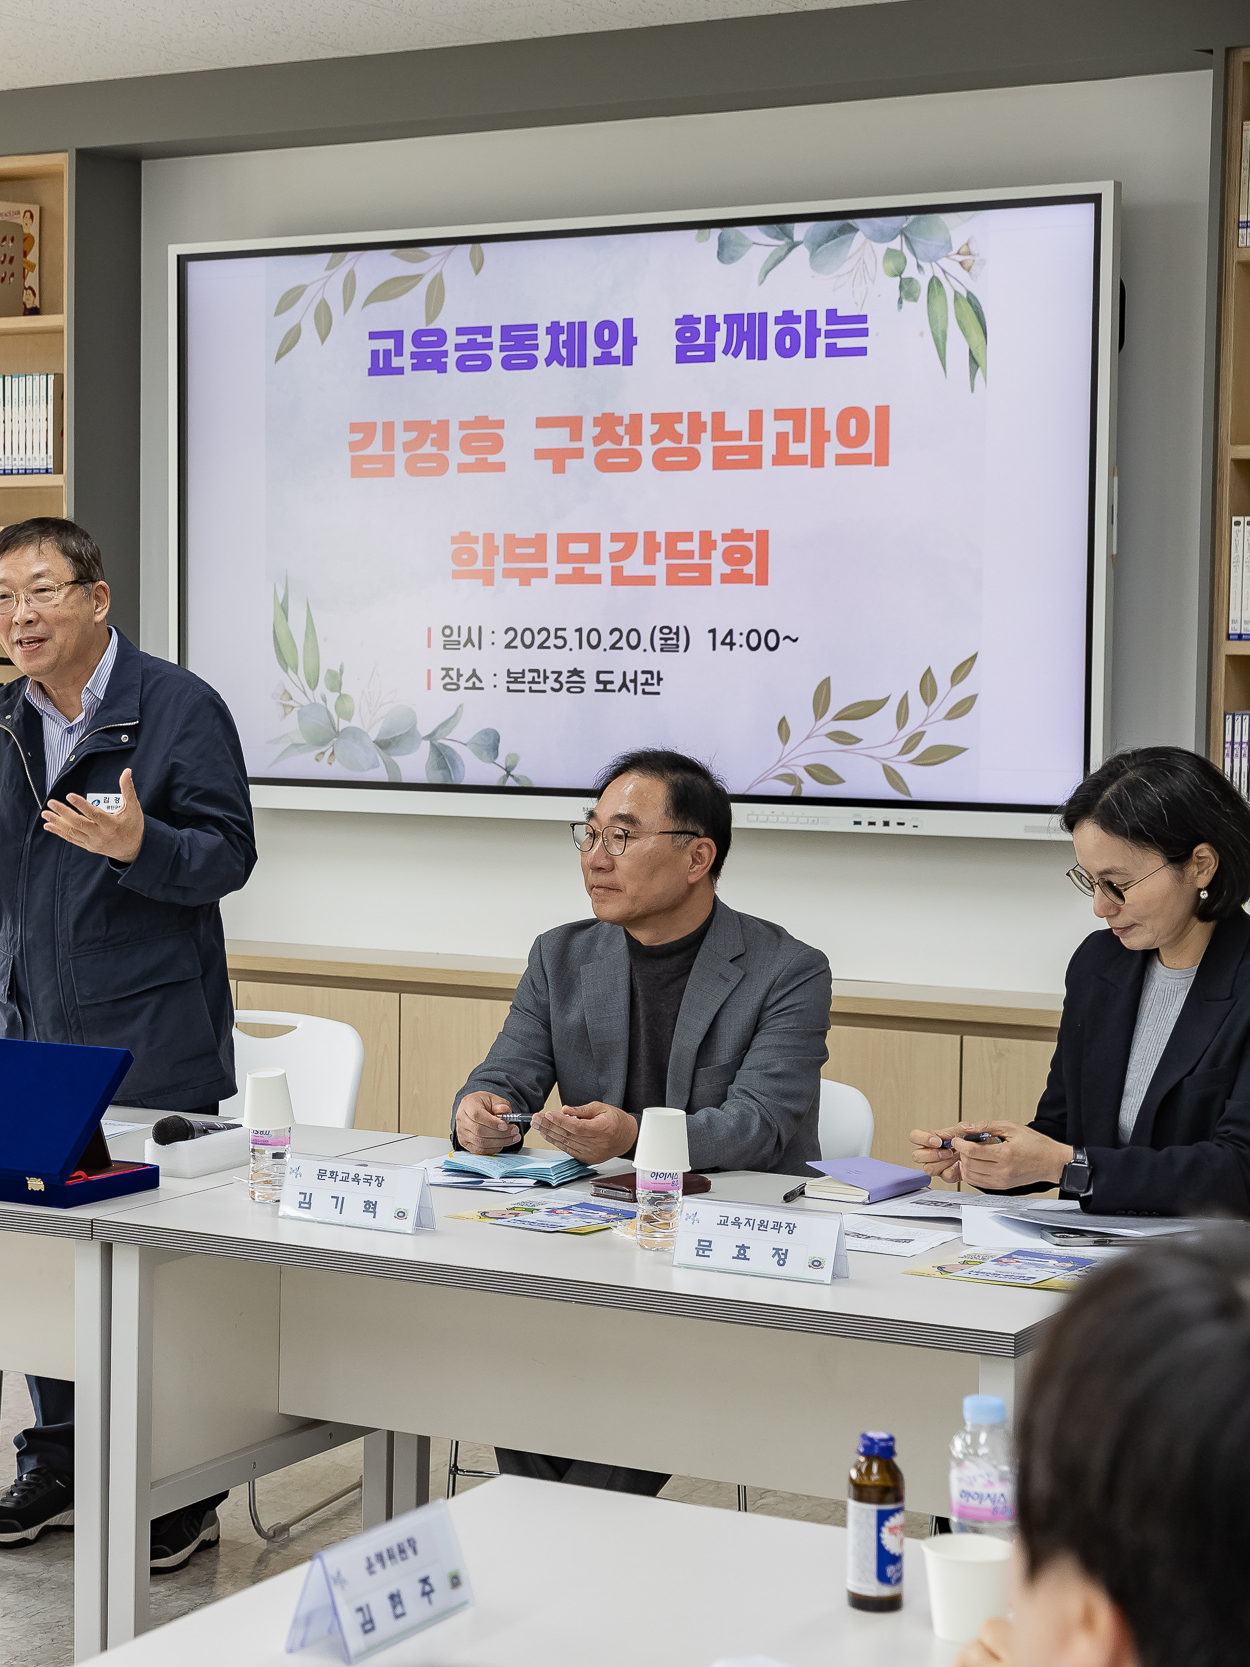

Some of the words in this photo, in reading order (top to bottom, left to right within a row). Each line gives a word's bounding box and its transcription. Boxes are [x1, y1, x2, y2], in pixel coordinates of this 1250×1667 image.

[367, 318, 637, 376] 교육공동체와
[675, 309, 869, 364] 함께하는
[348, 415, 507, 479] 김경호
[534, 405, 890, 474] 구청장님과의
[450, 528, 769, 587] 학부모간담회
[441, 625, 482, 651] 일시
[503, 625, 691, 653] 2025.10.20.(월)
[707, 628, 800, 652] 14:00~
[440, 667, 485, 691] 장소
[505, 668, 587, 694] 본관3층
[594, 670, 664, 695] 도서관
[316, 1168, 385, 1188] 문화교육국장
[716, 1214, 797, 1235] 교육지원과장
